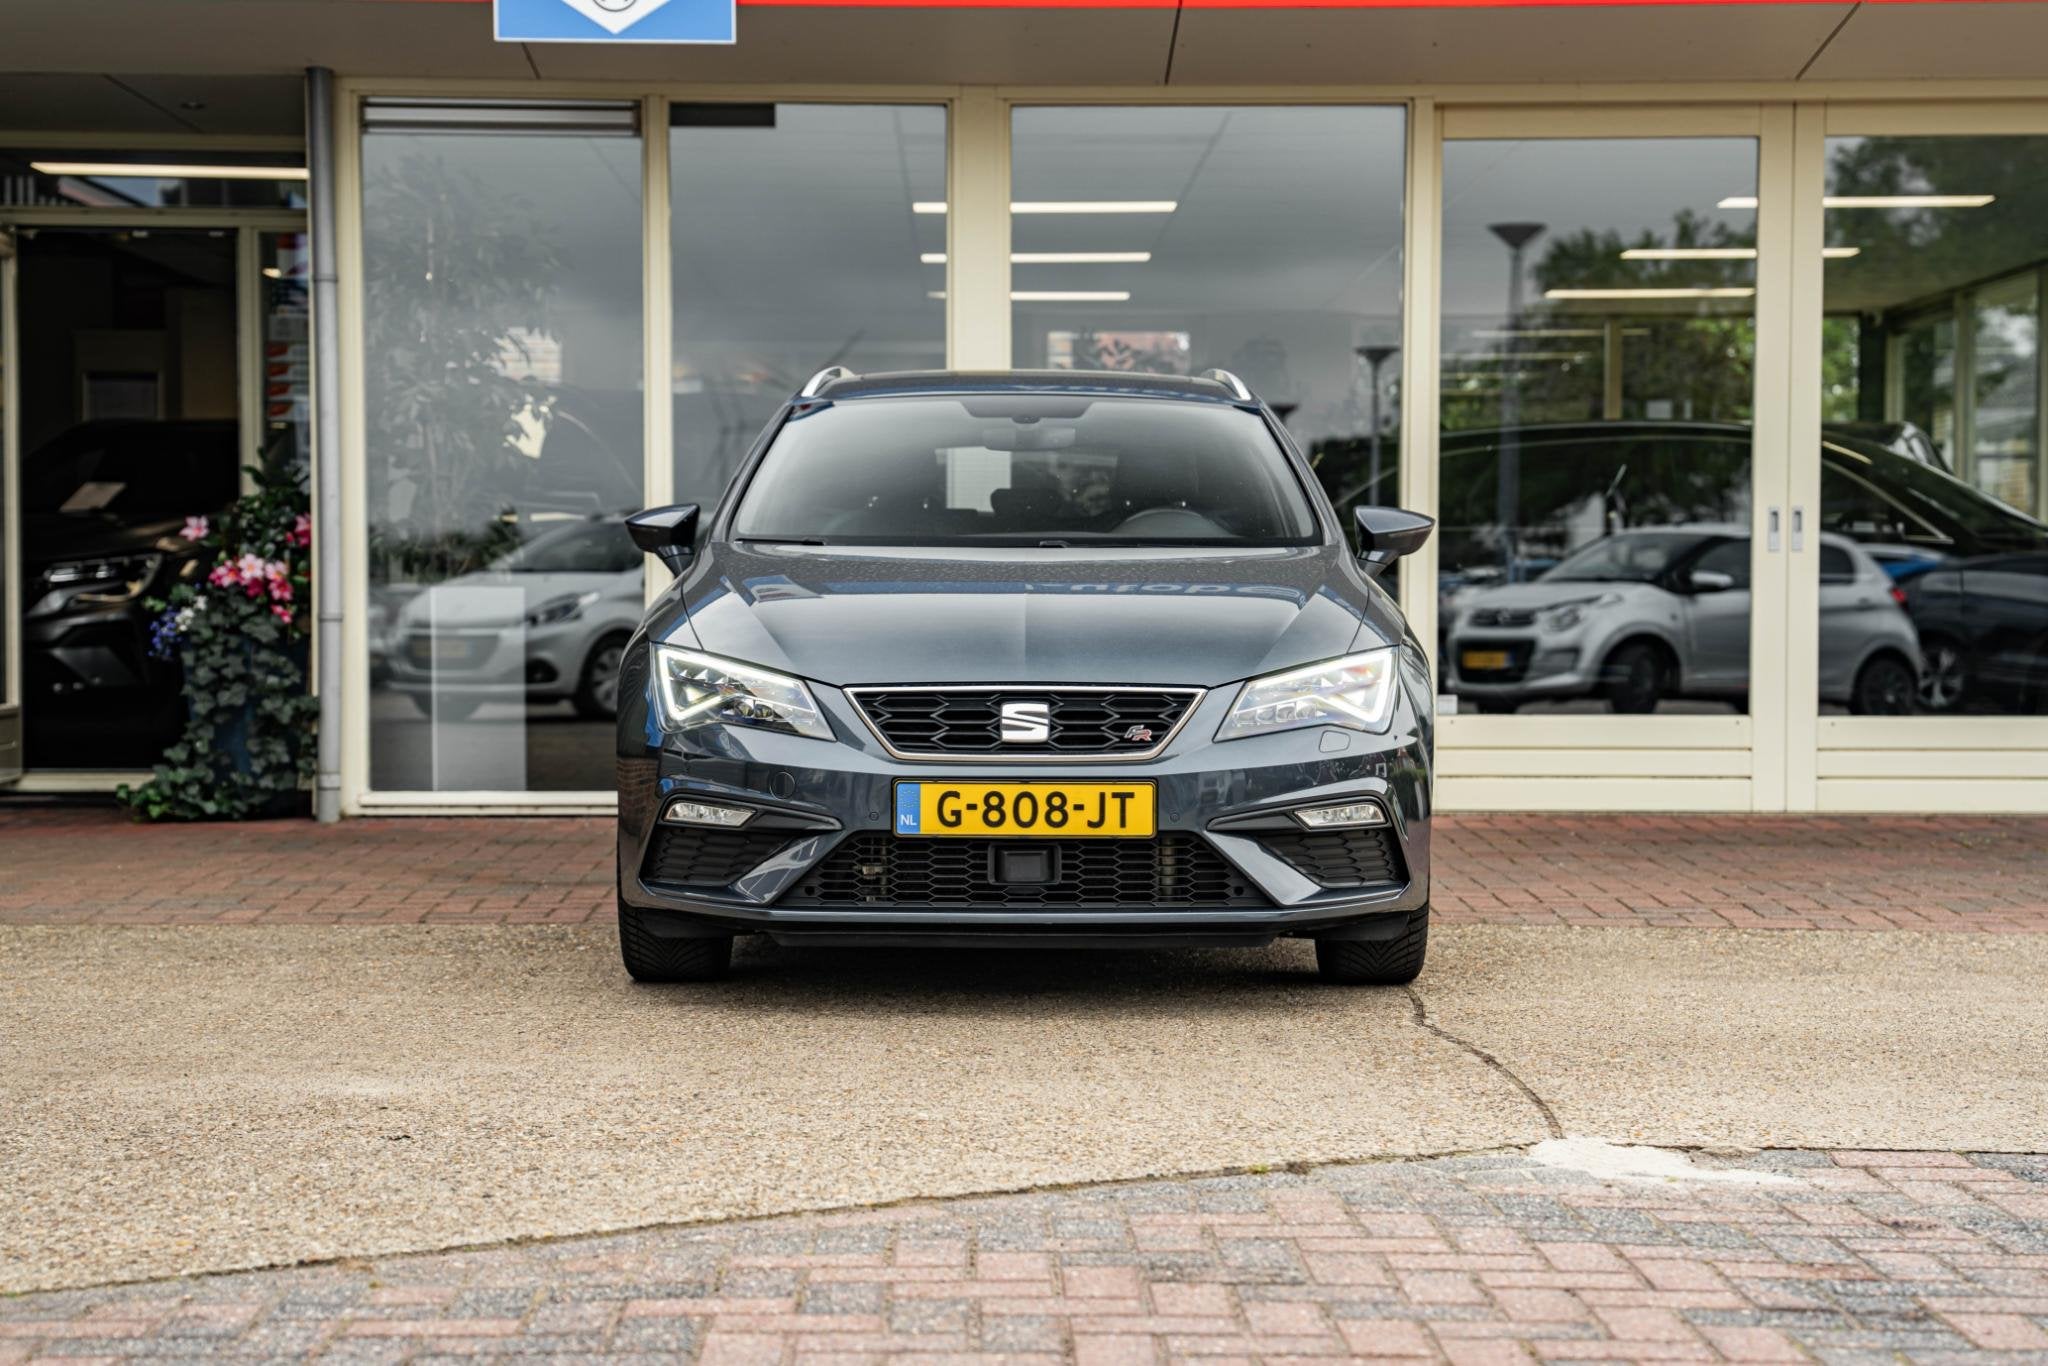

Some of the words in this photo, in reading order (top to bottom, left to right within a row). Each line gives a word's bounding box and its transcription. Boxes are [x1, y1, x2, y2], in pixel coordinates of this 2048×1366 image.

[1124, 724, 1153, 742] FR
[936, 790, 1136, 829] G-808-JT
[900, 815, 917, 826] NL
